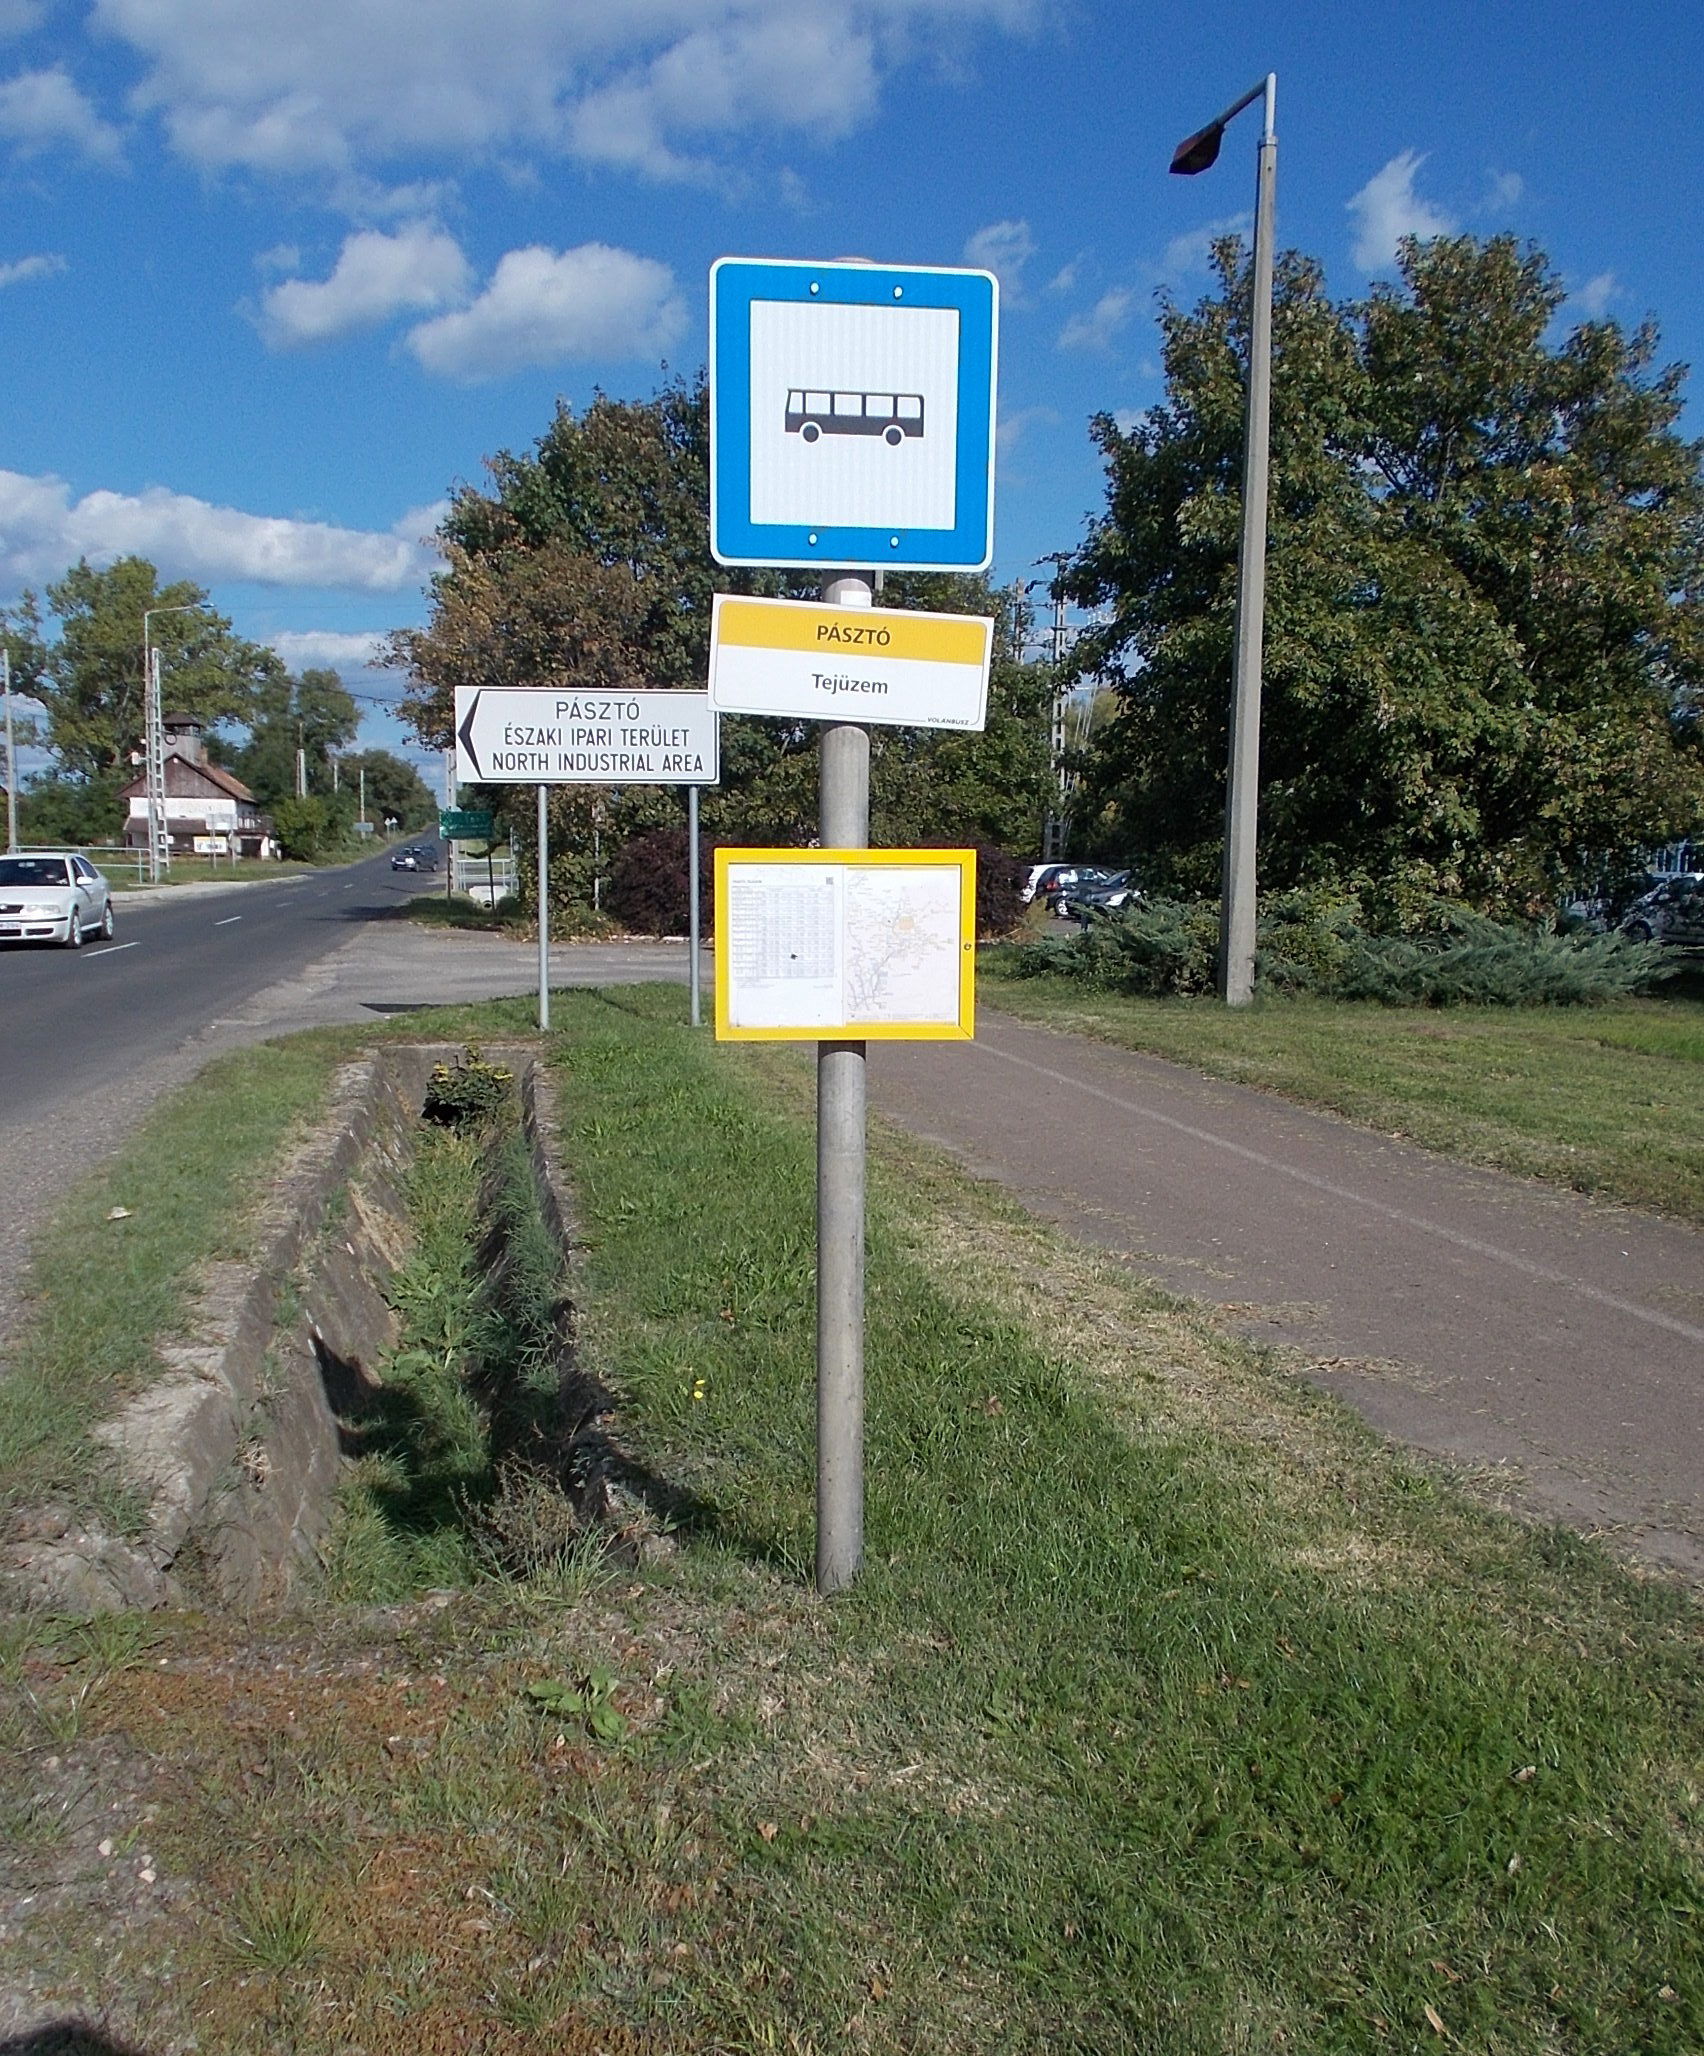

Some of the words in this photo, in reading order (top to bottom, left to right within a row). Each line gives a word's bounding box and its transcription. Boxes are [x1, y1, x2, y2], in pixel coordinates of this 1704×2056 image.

[817, 623, 890, 646] PÁSZTÓ
[812, 674, 888, 695] Tejüzem
[556, 697, 639, 721] PÁSZTÓ
[504, 723, 562, 746] ÉSZAKI
[571, 728, 611, 746] IPARI
[620, 725, 690, 746] TERÜLET
[492, 753, 549, 771] NORTH
[558, 754, 655, 772] INDUSTRIAL
[662, 754, 704, 772] AREA
